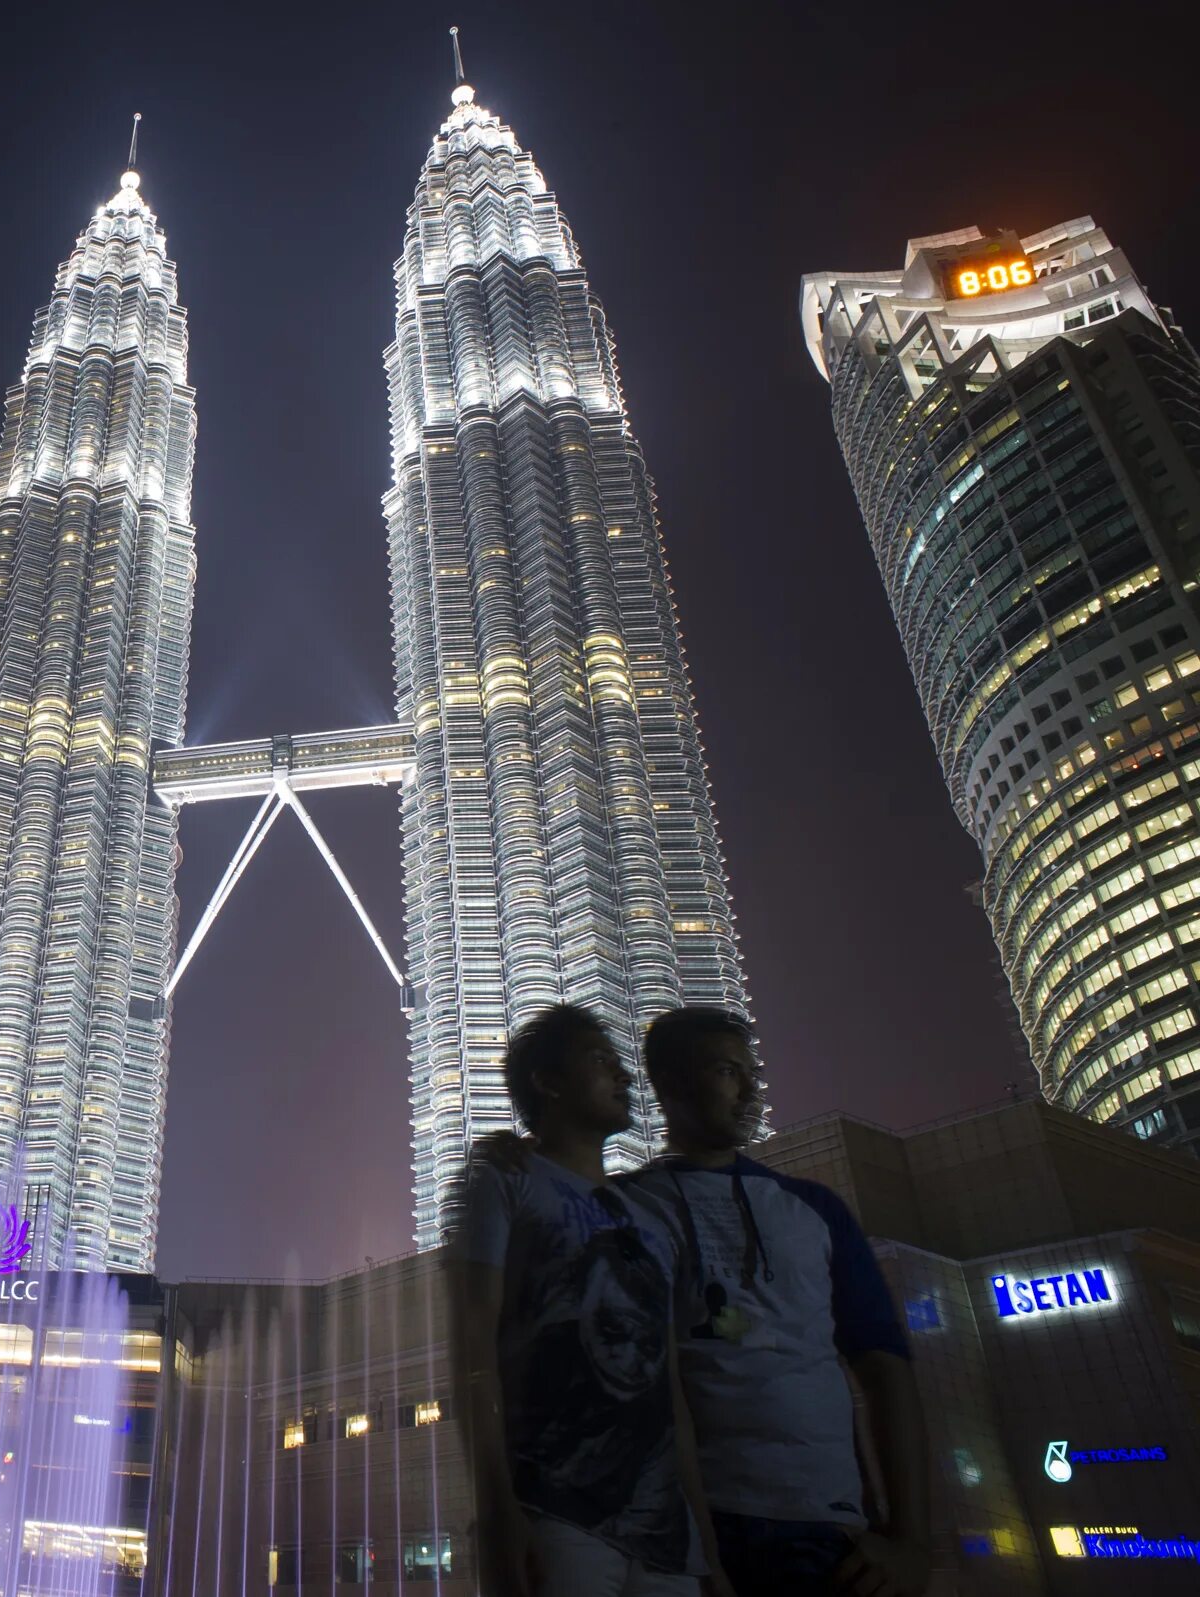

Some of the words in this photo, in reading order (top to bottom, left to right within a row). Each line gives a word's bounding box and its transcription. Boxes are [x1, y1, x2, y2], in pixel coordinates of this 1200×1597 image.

[959, 260, 1032, 296] 8:06
[1069, 1446, 1168, 1464] PETROSAINS
[1083, 1527, 1114, 1535] GALERI
[1115, 1526, 1139, 1535] BUKU
